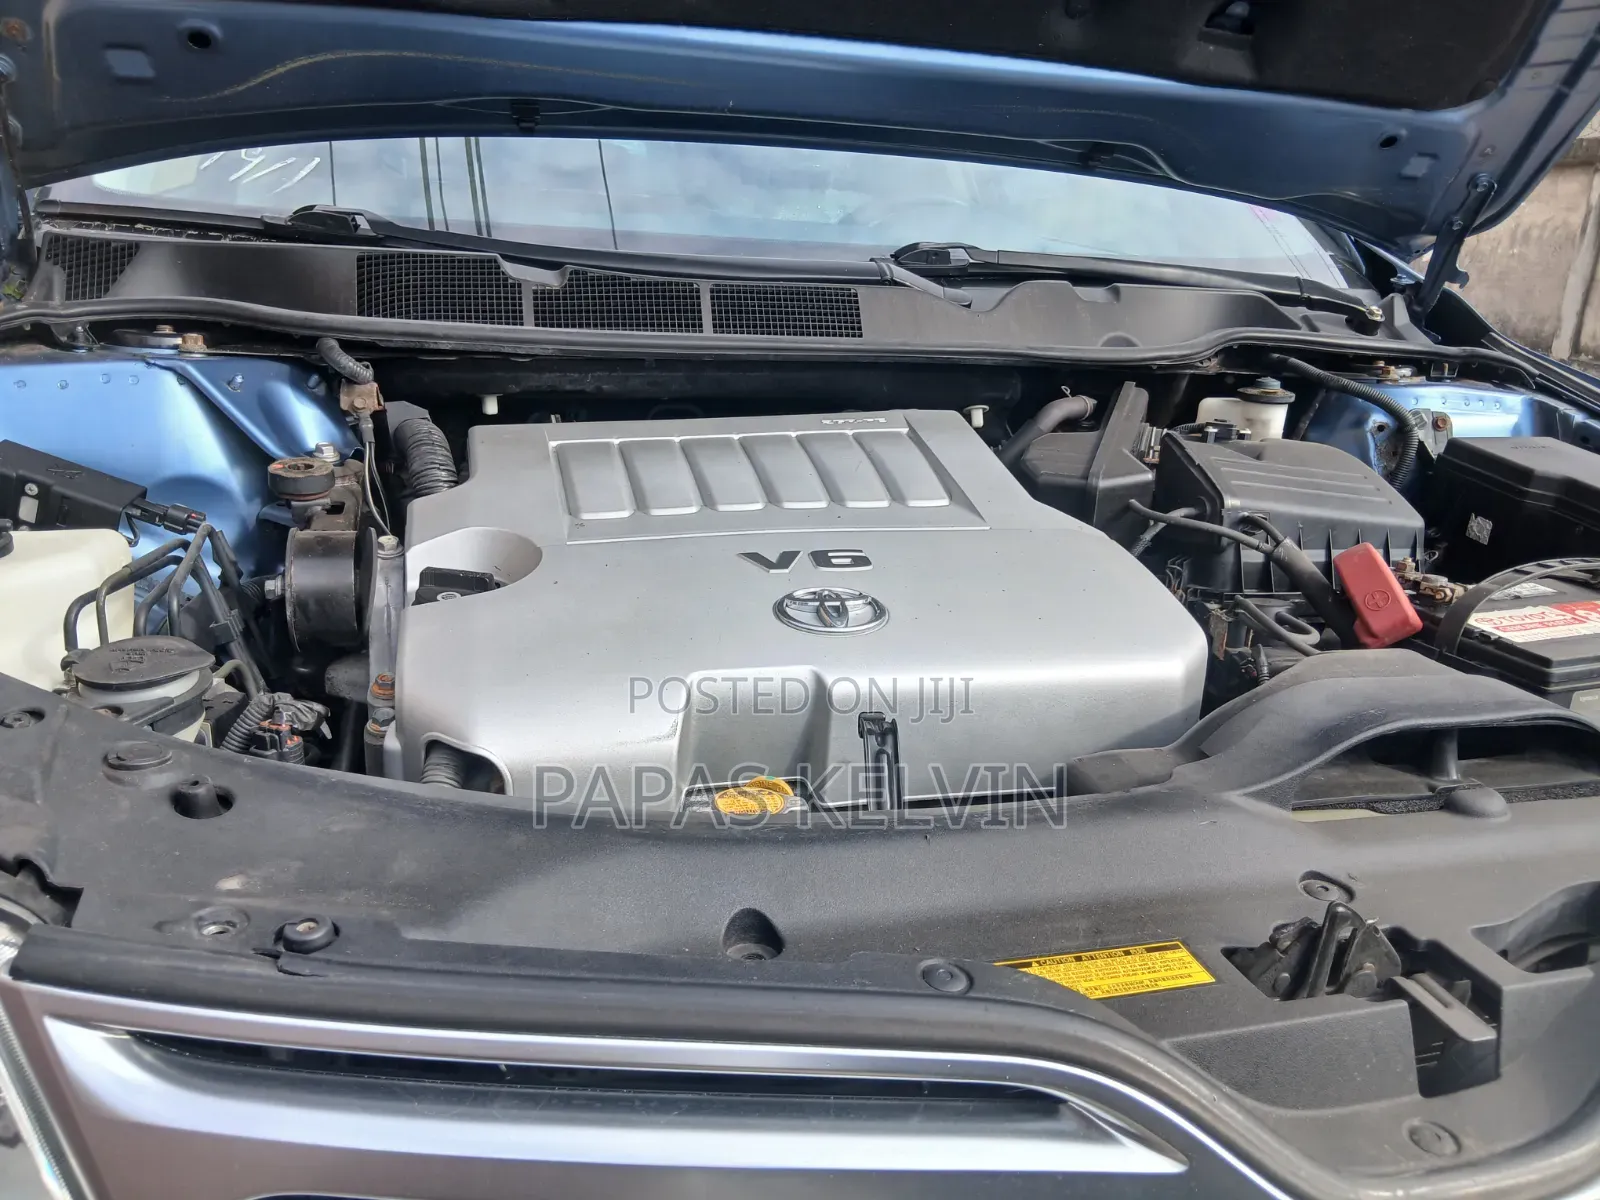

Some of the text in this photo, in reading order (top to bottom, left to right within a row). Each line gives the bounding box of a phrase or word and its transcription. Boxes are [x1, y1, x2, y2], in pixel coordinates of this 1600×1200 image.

[737, 549, 873, 573] V6
[1040, 956, 1075, 966] CAUTION
[1081, 950, 1124, 961] ATTENTION
